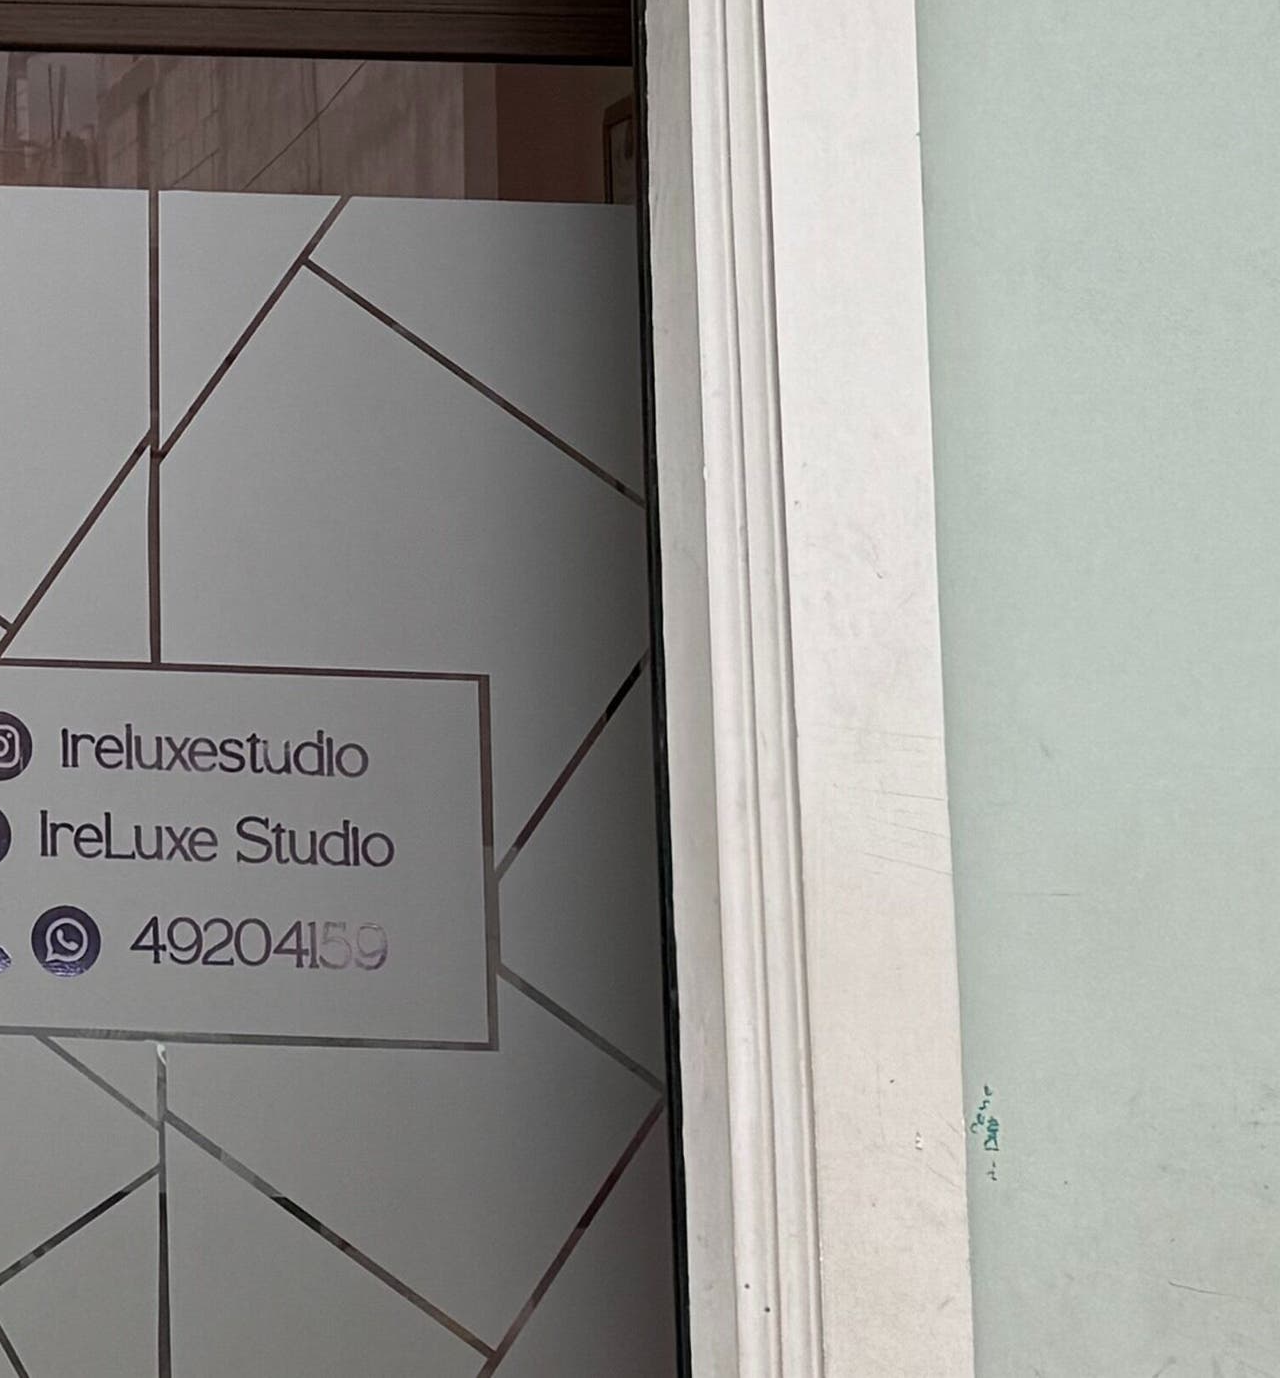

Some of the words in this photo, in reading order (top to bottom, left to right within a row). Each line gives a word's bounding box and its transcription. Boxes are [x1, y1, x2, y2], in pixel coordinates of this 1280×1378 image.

[39, 809, 219, 863] IreLuxe
[236, 815, 396, 868] Studio
[129, 915, 389, 971] 49204159
